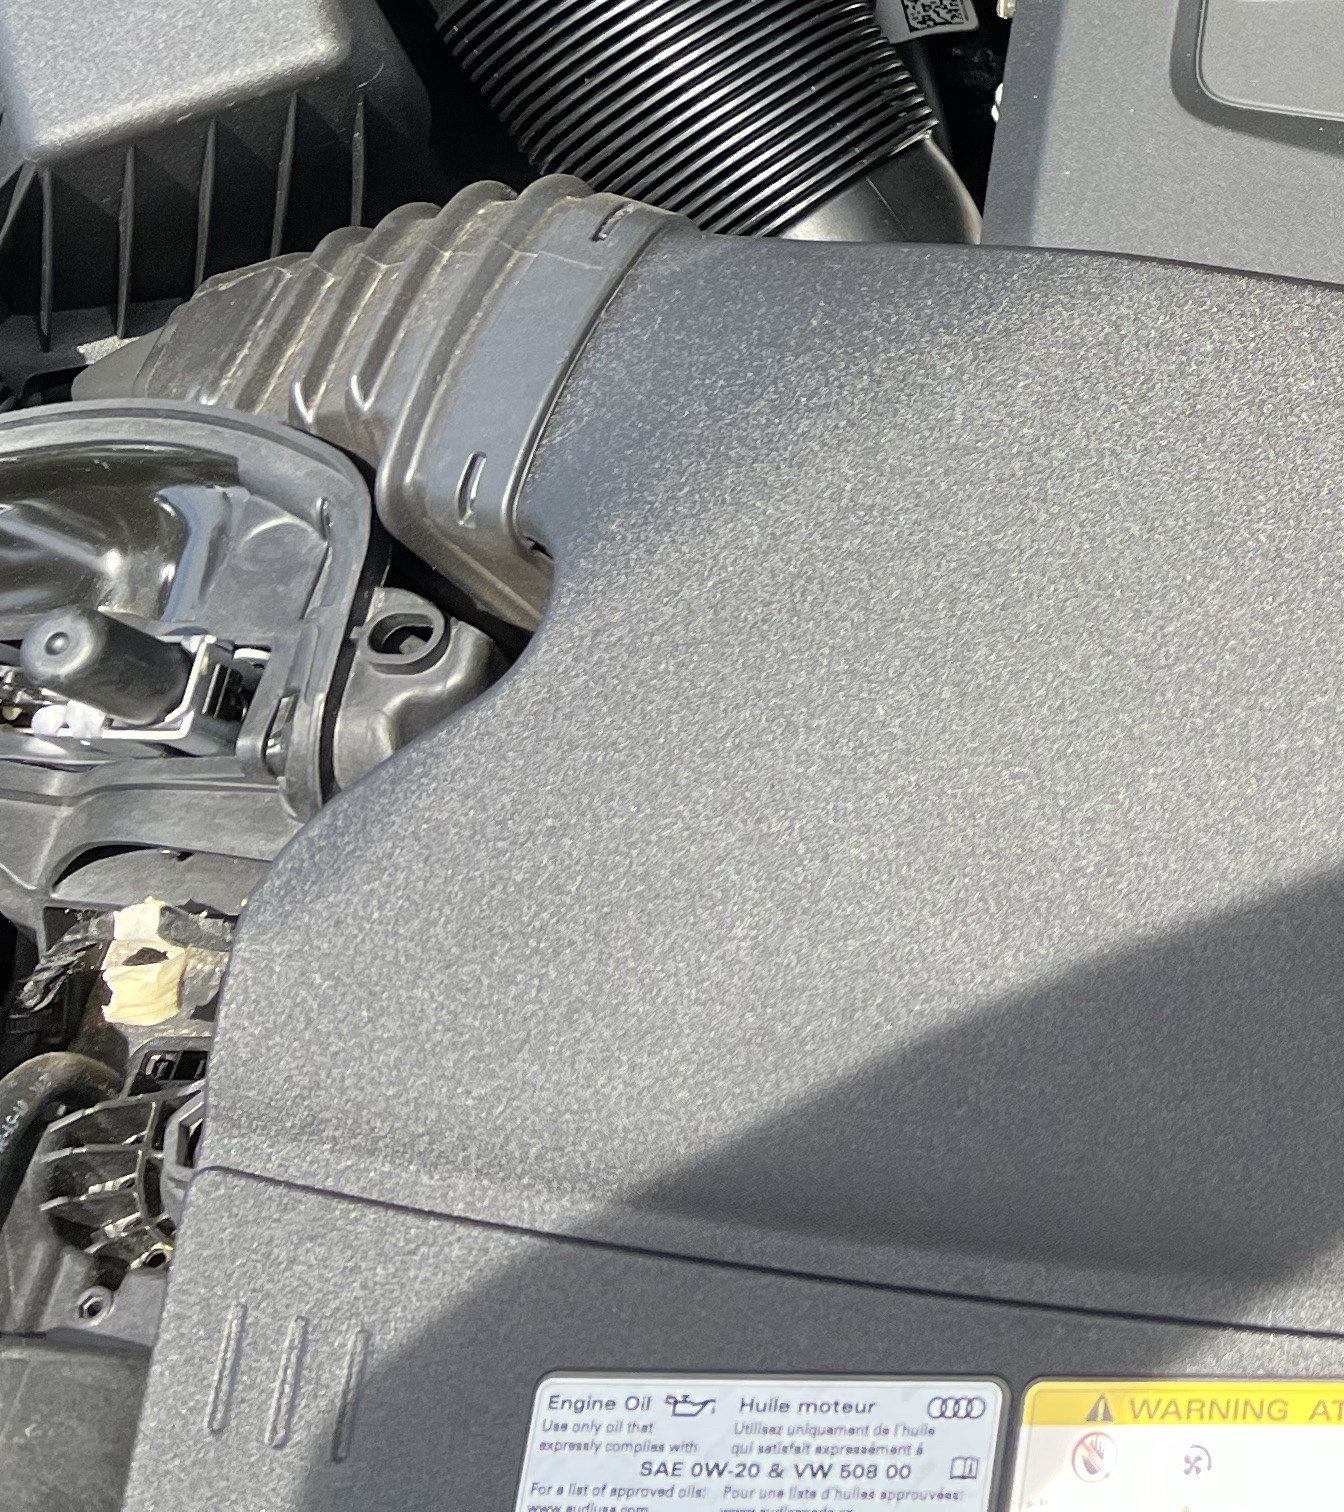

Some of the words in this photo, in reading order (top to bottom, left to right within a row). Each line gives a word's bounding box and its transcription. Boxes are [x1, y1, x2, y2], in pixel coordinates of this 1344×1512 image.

[548, 1394, 616, 1414] Engine
[625, 1395, 651, 1411] Oil
[739, 1397, 790, 1413] Huile
[798, 1398, 877, 1414] moteur
[1129, 1398, 1289, 1421] WARNING
[542, 1419, 568, 1433] Use
[572, 1421, 601, 1436] only
[606, 1420, 623, 1433] oil
[628, 1420, 655, 1433] that
[787, 1423, 869, 1438] uniquement
[874, 1423, 889, 1436] de
[606, 1441, 665, 1455] complies
[670, 1441, 698, 1454] with
[731, 1443, 753, 1457] qui
[640, 1461, 684, 1477] SAE
[691, 1462, 760, 1478] 0W-20
[767, 1463, 784, 1479] &
[794, 1463, 833, 1479] VW
[840, 1463, 878, 1479] 508
[886, 1464, 911, 1479] 00
[530, 1482, 552, 1497] For
[556, 1486, 564, 1496] a
[568, 1483, 588, 1497] list
[592, 1482, 607, 1497] of
[610, 1484, 673, 1499] approved
[723, 1486, 756, 1500] Pour
[759, 1489, 784, 1500] une
